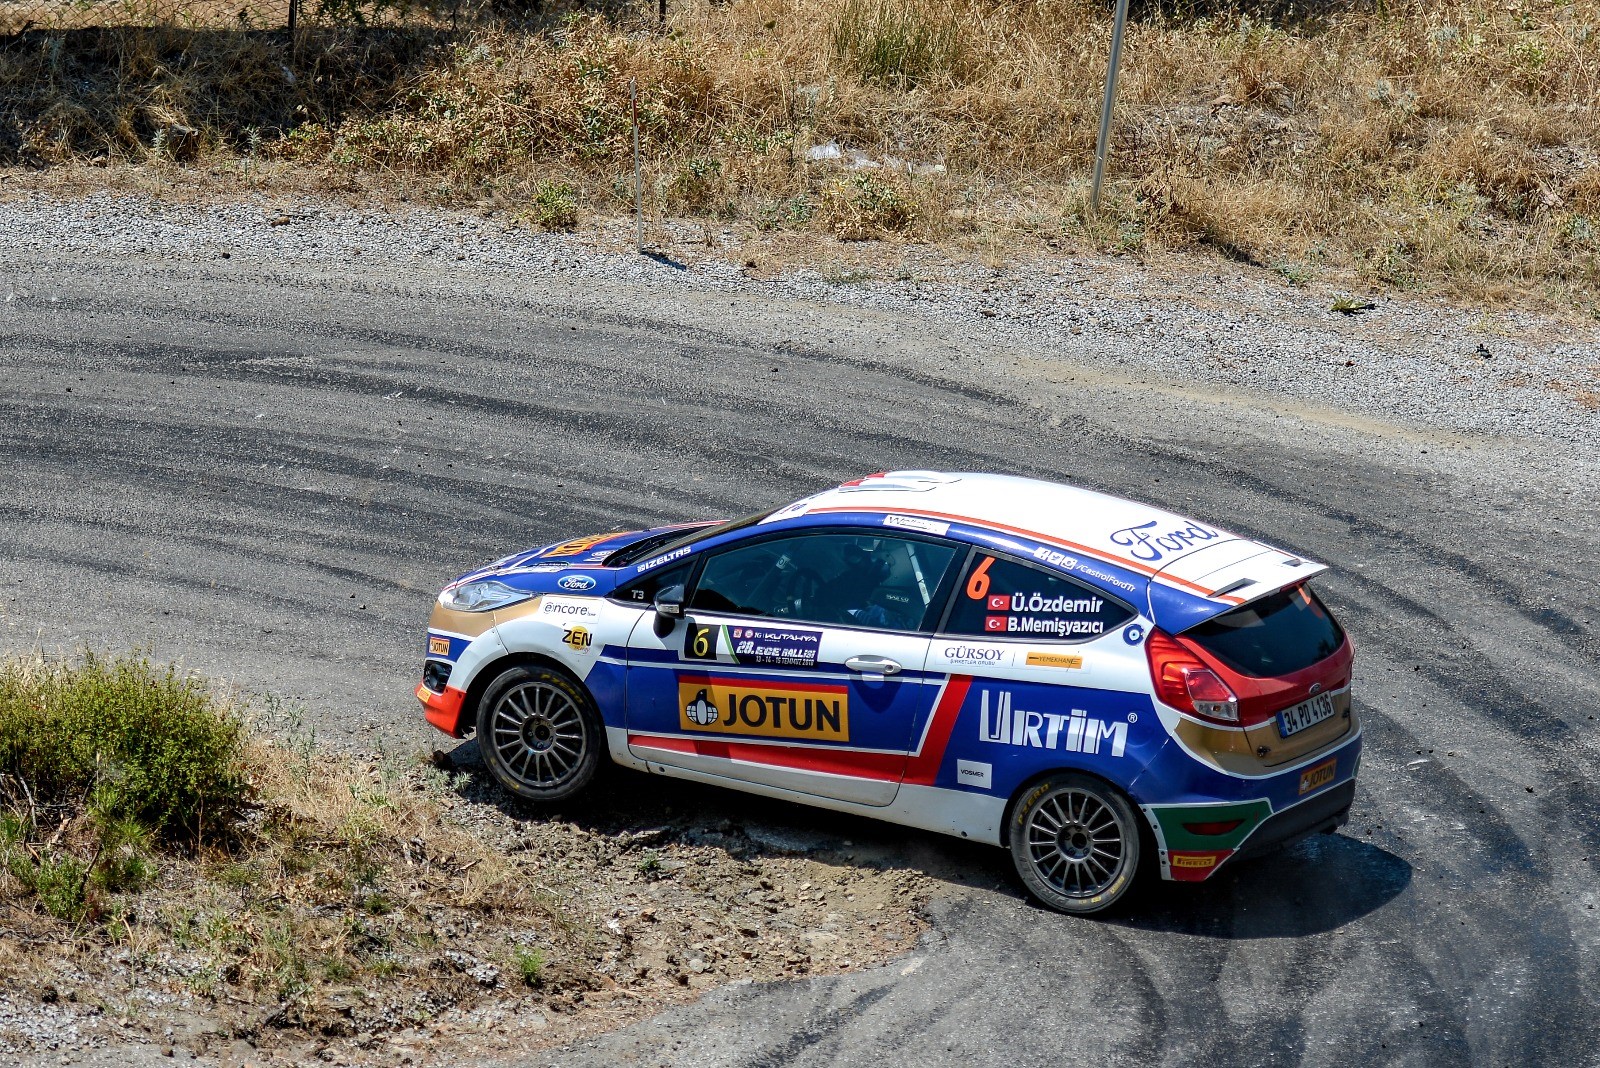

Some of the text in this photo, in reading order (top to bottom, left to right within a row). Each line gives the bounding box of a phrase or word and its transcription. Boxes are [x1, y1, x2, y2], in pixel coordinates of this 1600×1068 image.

[1110, 520, 1219, 561] Ford
[562, 576, 589, 590] Ford
[966, 556, 996, 600] 6
[631, 589, 645, 600] T3
[1011, 592, 1104, 613] Ü.Özdemir
[1007, 616, 1104, 637] B.Memişyazıcı
[562, 629, 593, 646] ZEN
[693, 628, 710, 657] 6
[944, 646, 1005, 661] GÜRSOY
[1038, 656, 1081, 665] YEMEKHANE
[723, 693, 841, 733] JOTUN
[1284, 693, 1332, 733] 34 PD 4136
[1309, 763, 1334, 787] JOTUN
